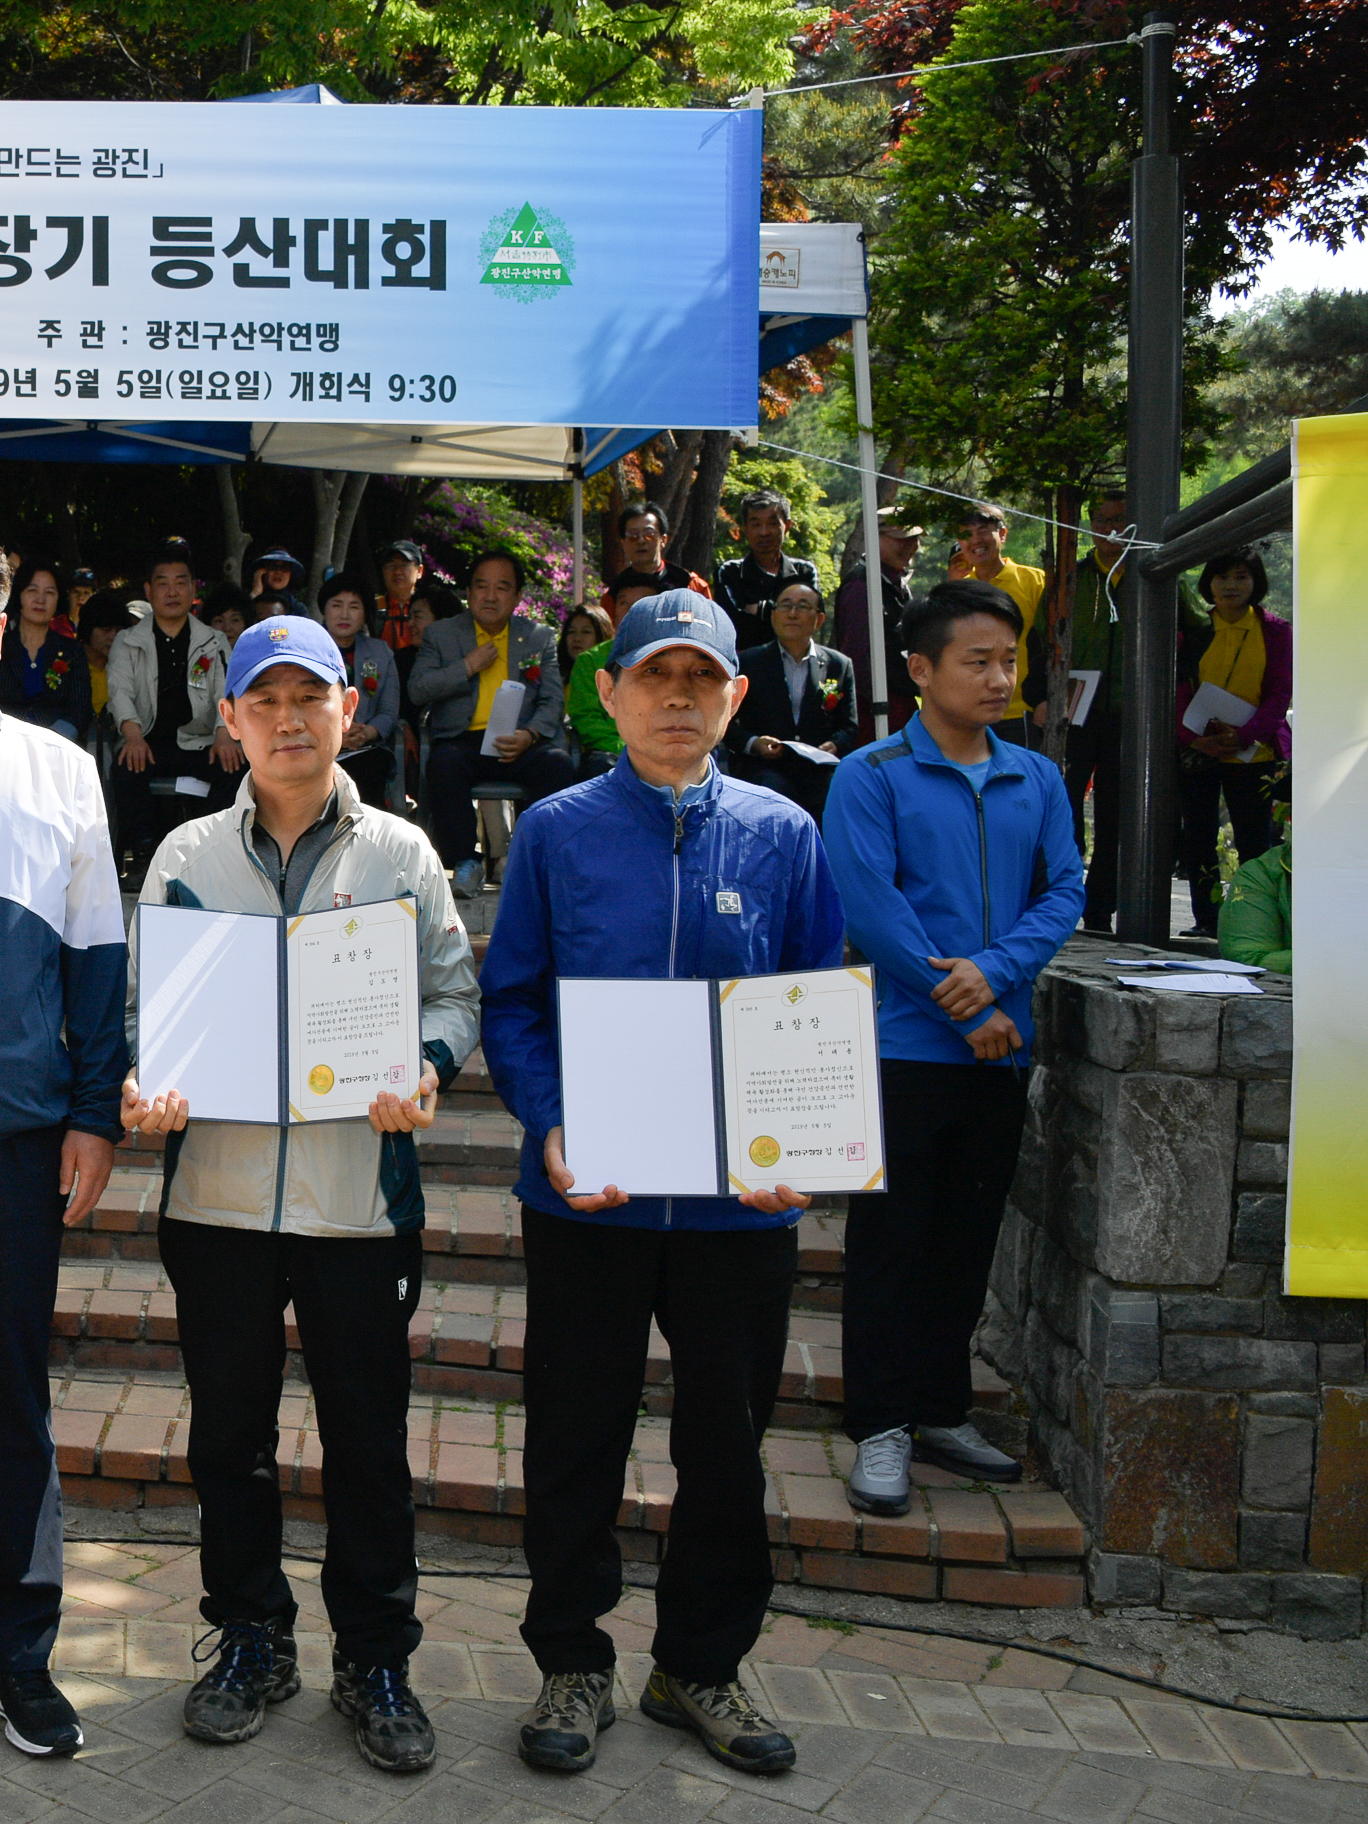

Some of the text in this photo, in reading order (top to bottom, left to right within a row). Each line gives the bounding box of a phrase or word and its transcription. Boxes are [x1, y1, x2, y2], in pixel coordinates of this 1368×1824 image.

[149, 216, 447, 292] 등산대회
[490, 266, 562, 280] 광진구산악연맹
[146, 320, 340, 353] 광진구산악연맹
[54, 368, 99, 399] 5월
[116, 369, 272, 401] 5일(일요일)
[289, 371, 371, 403] 개회식
[388, 373, 457, 403] 9:30
